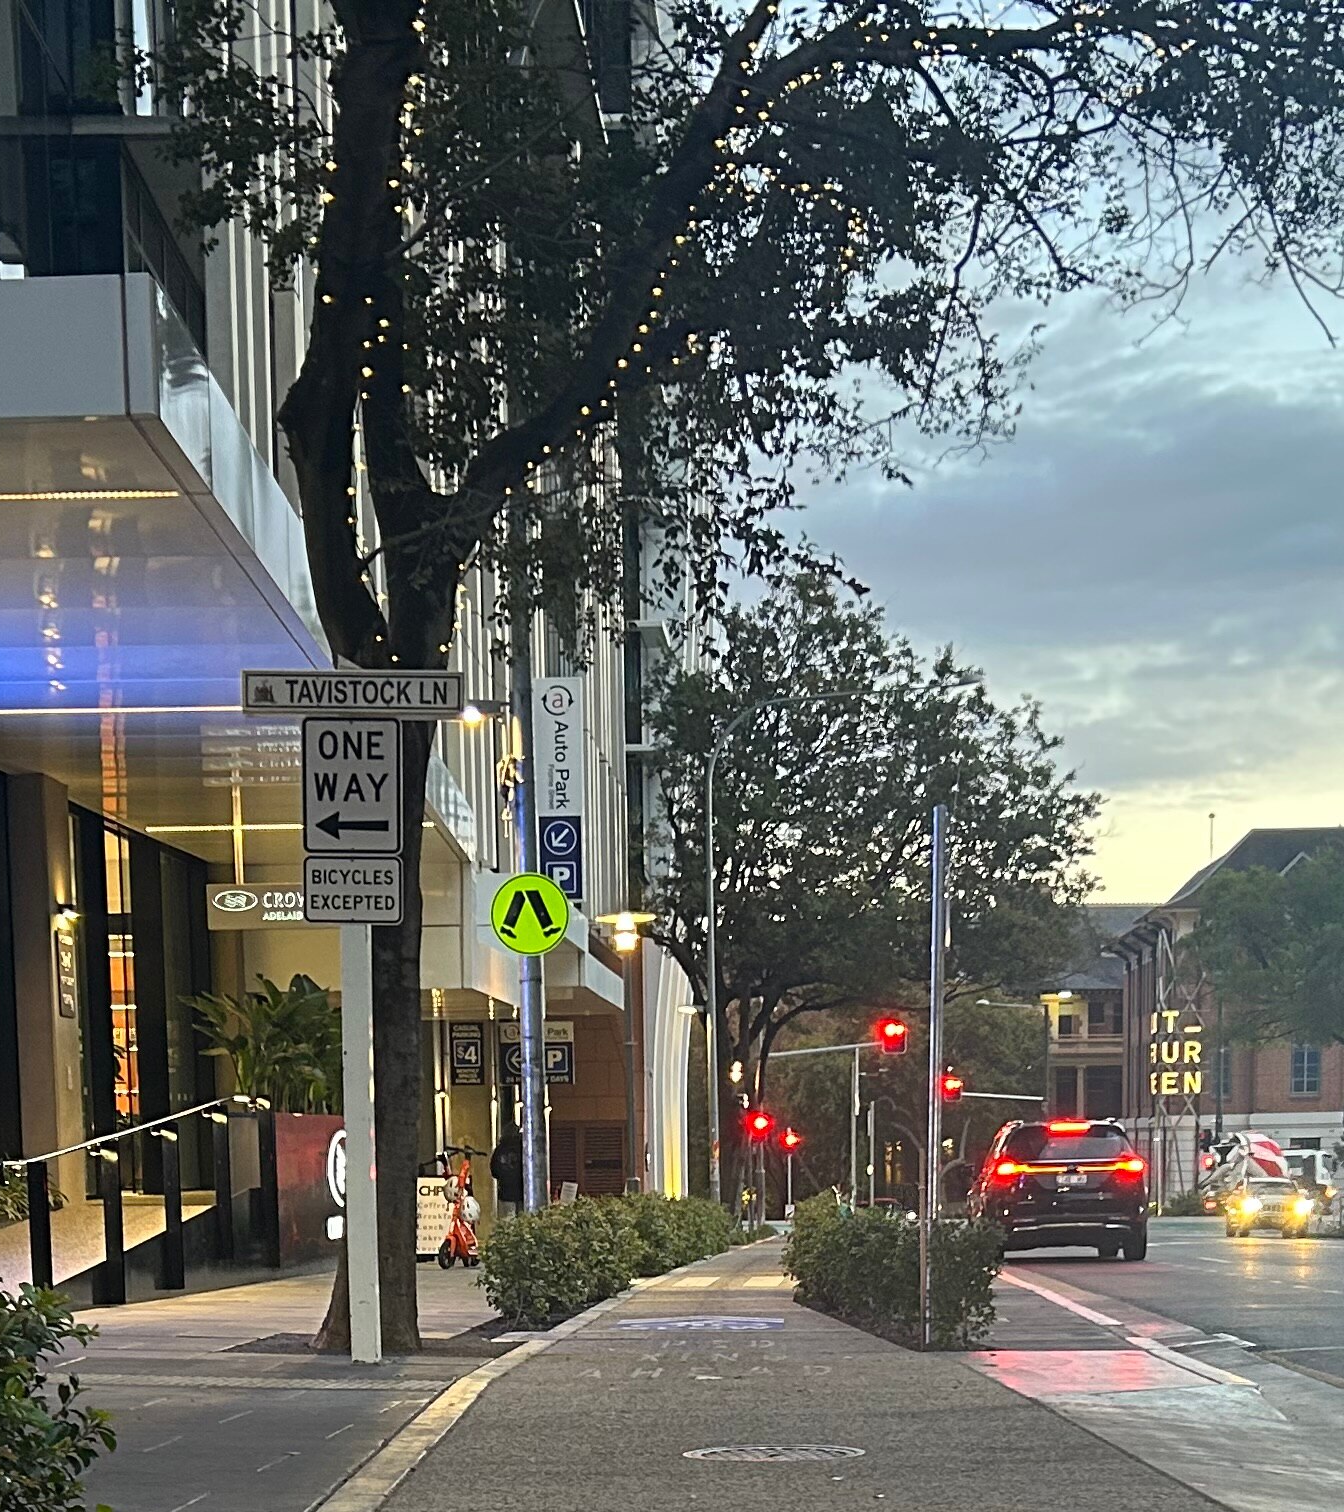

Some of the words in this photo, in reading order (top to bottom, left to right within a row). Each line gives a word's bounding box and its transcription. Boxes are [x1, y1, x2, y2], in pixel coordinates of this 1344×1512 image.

[285, 679, 411, 705] TAVISTOCK
[419, 681, 448, 705] LN
[318, 730, 385, 761] ONE
[554, 720, 569, 763] Auto
[314, 772, 389, 802] WAY
[555, 768, 570, 810] Park
[311, 869, 394, 886] BICYCLES
[310, 894, 396, 911] EXCEPTED
[547, 1028, 569, 1036] Park
[456, 1046, 477, 1063] $4
[547, 1050, 563, 1069] P
